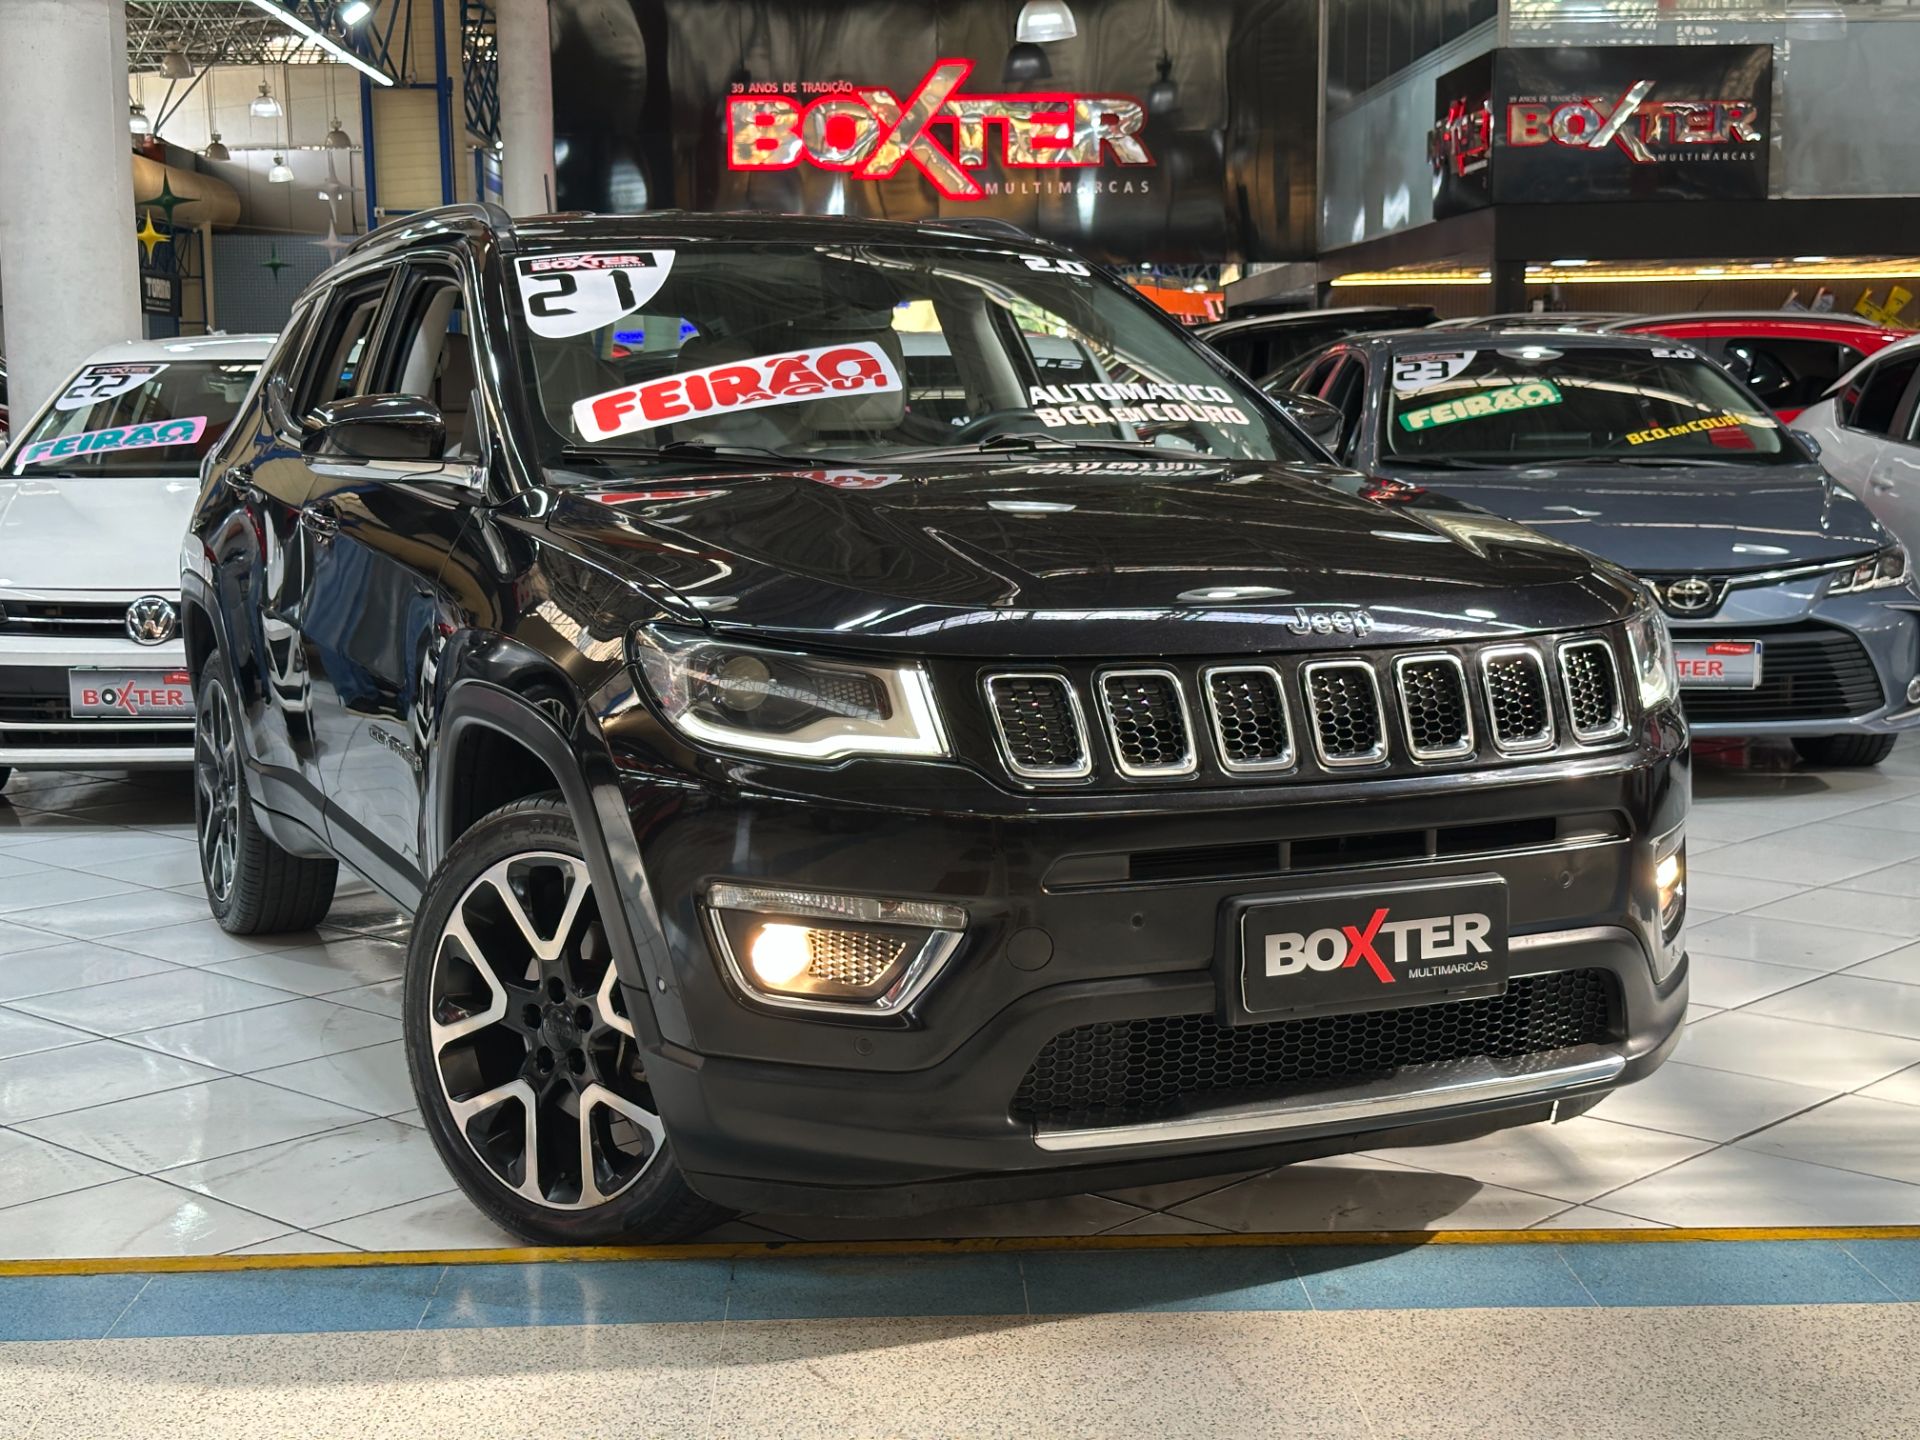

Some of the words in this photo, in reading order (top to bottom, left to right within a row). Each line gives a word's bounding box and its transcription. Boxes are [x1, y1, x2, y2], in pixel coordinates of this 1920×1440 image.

[731, 83, 744, 93] 39
[749, 83, 778, 93] ANOS
[783, 83, 797, 93] DE
[802, 80, 853, 94] TRADIÇÃO
[727, 60, 1156, 200] BOXTER
[1506, 80, 1762, 164] BOXTER
[1658, 153, 1756, 162] MULTIMARCAS
[985, 181, 1150, 195] MULTIMARCAS
[531, 255, 640, 272] BOXTER
[1019, 255, 1091, 277] 2.0
[528, 269, 636, 317] 21
[1651, 348, 1696, 359] 2.0
[1397, 361, 1449, 380] 23
[64, 374, 131, 399] 22
[592, 348, 882, 432] FEIRÃO
[1110, 407, 1149, 423] EM
[1143, 404, 1250, 426] COURO
[1407, 384, 1553, 428] FEIRÃO
[24, 420, 196, 462] FEIRÃO
[1668, 424, 1690, 436] EM
[1287, 607, 1375, 637] Jeep
[82, 680, 185, 715] BOXTER
[1265, 908, 1492, 984] BOXTER
[1408, 960, 1489, 979] MULTIMARCAS
